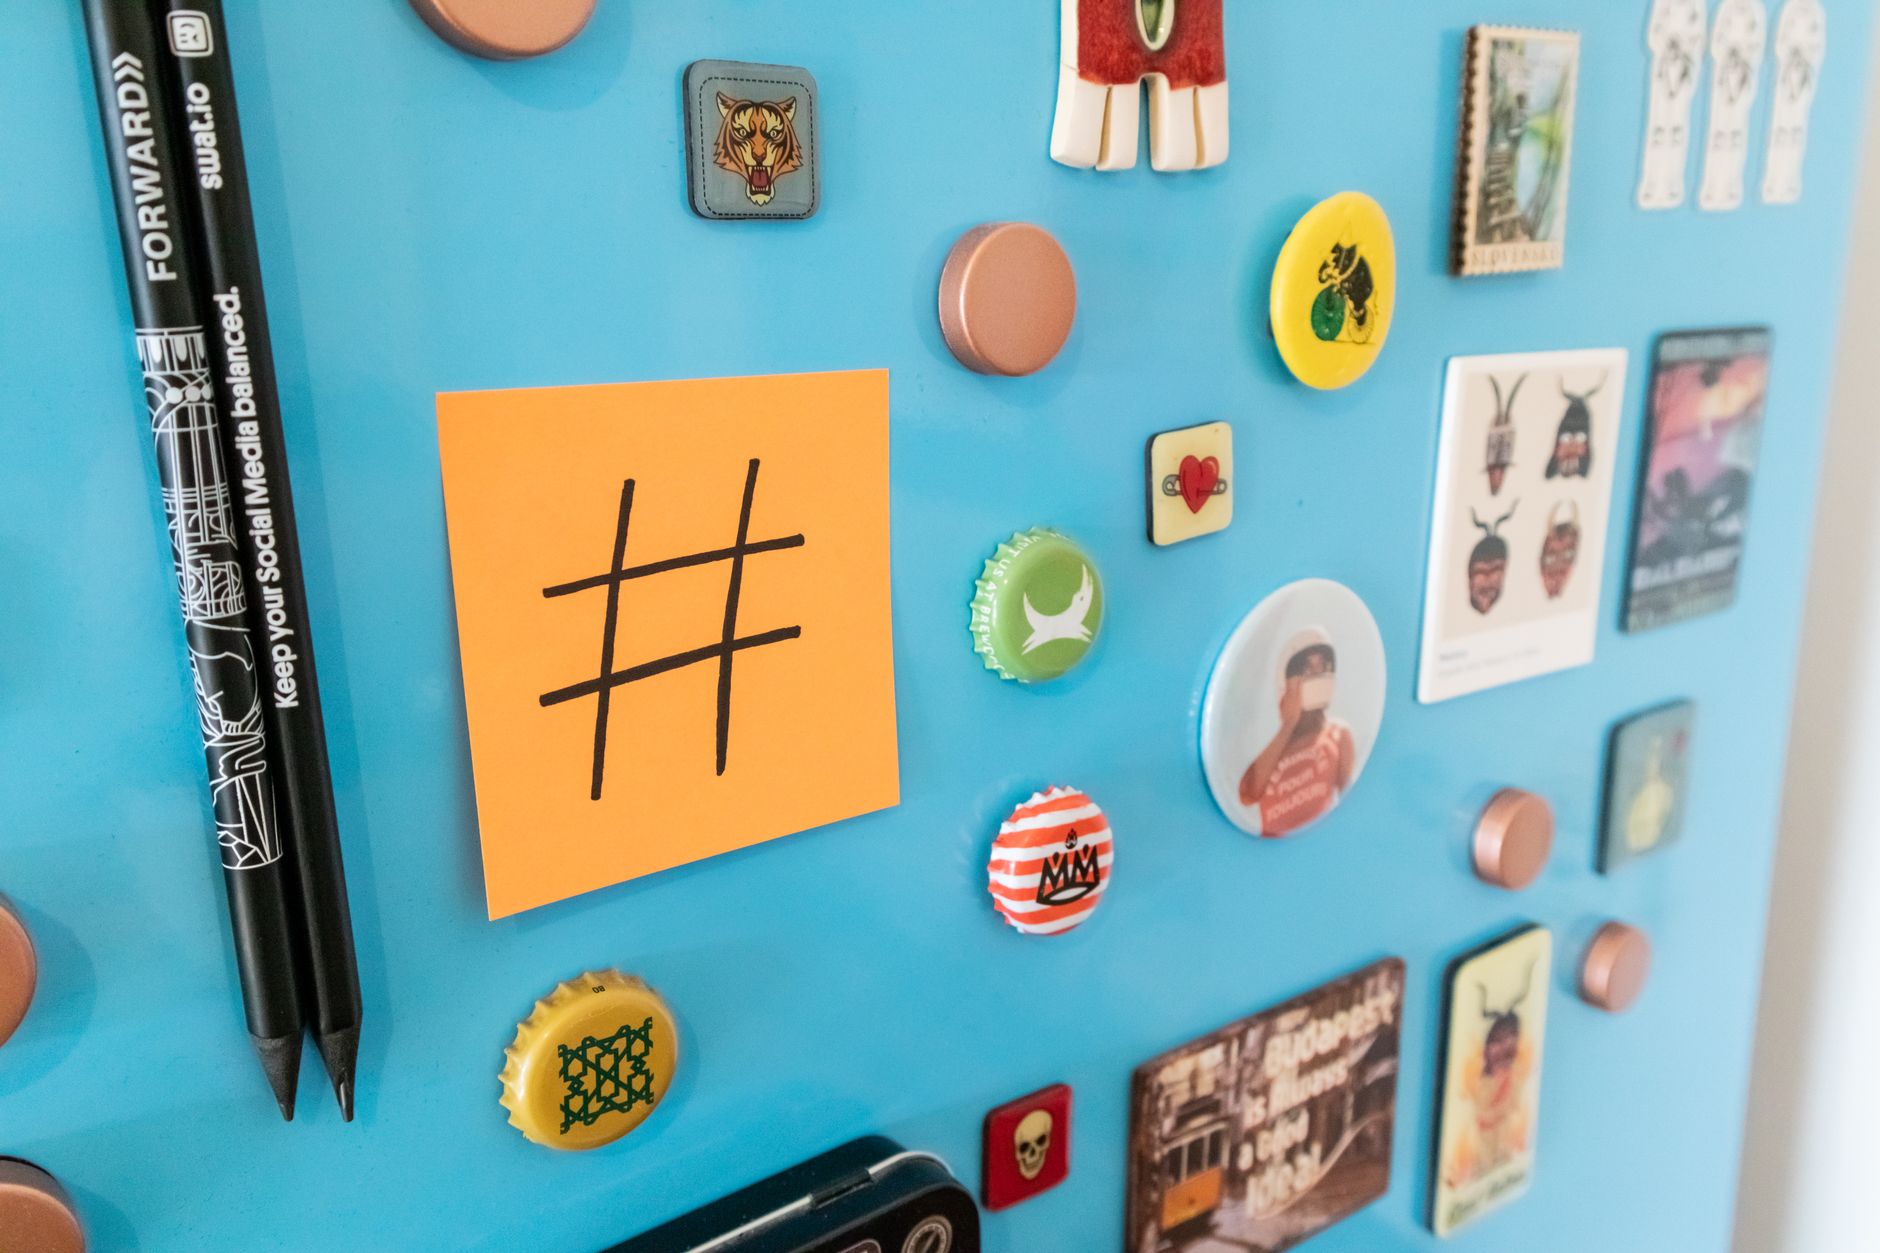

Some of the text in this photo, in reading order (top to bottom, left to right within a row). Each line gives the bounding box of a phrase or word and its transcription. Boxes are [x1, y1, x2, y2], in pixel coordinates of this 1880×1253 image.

[186, 82, 223, 190] swat.io
[214, 286, 299, 709] Keep your Social Media balanced.
[984, 581, 997, 602] AT
[993, 559, 1011, 577] US
